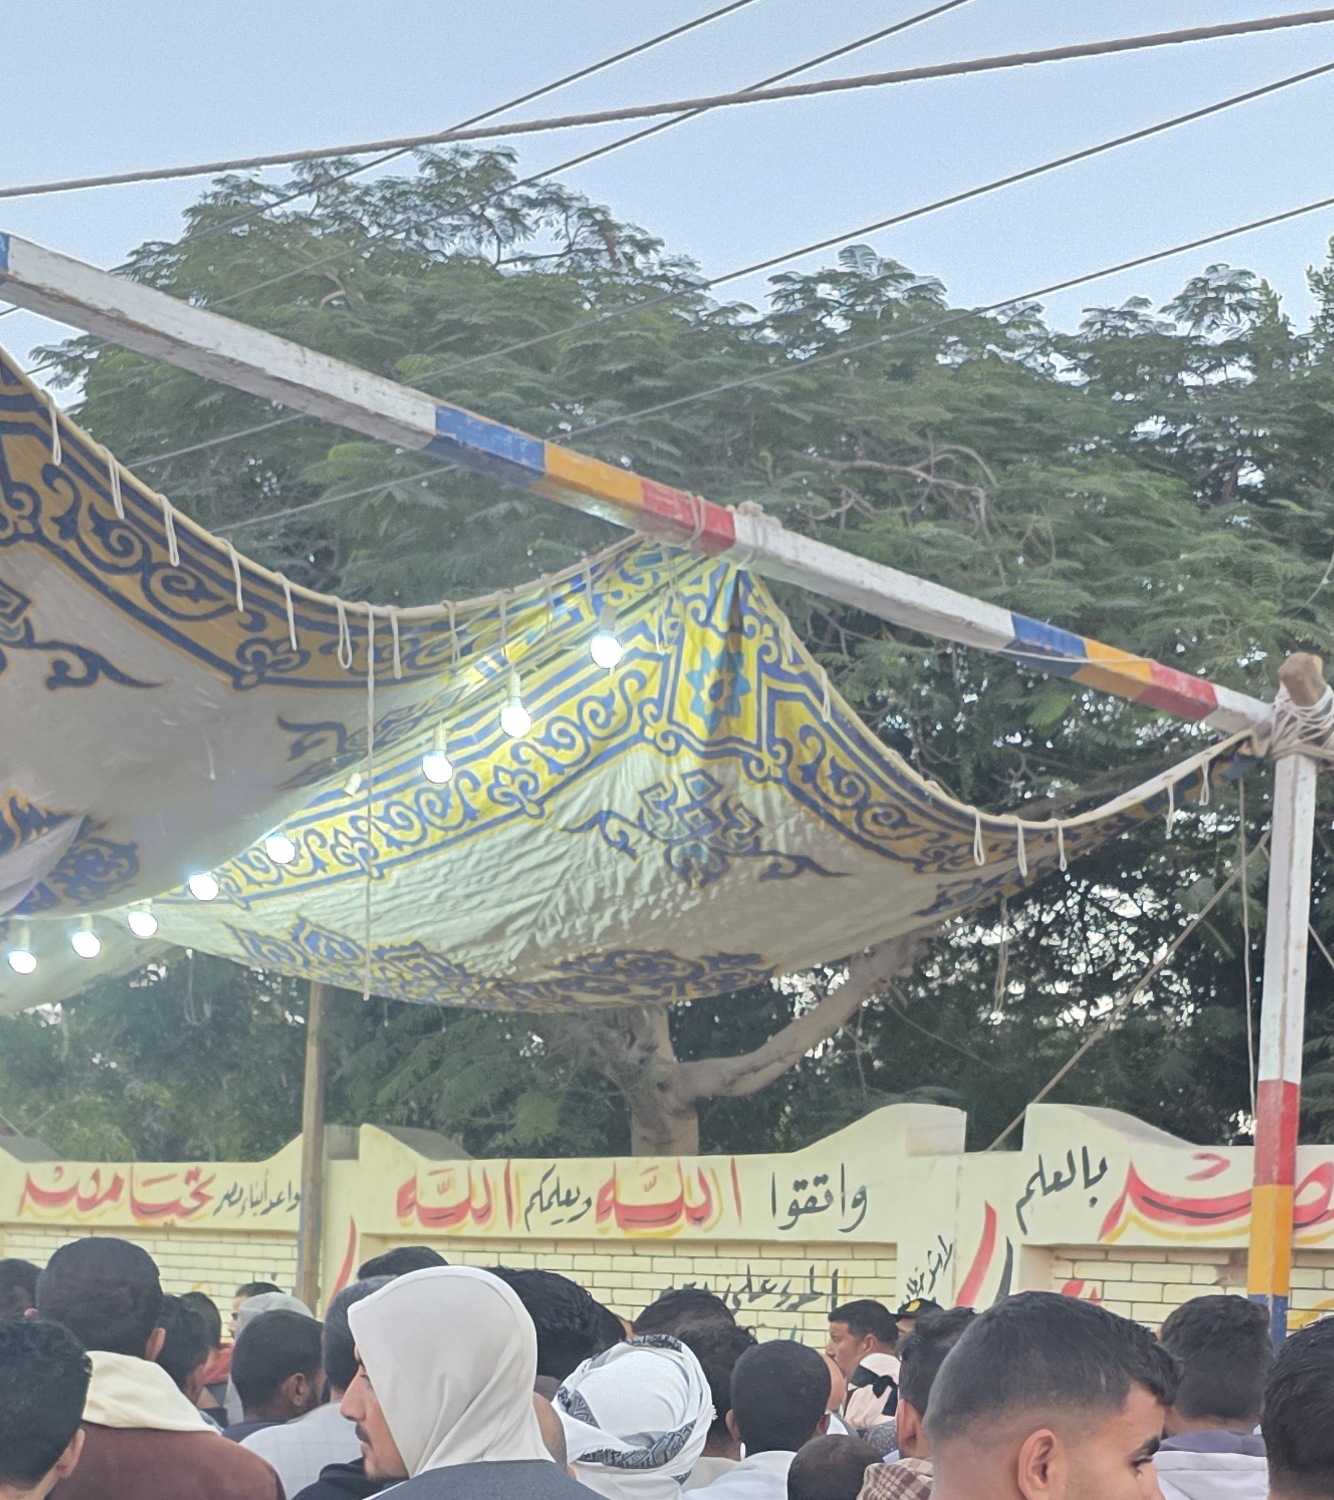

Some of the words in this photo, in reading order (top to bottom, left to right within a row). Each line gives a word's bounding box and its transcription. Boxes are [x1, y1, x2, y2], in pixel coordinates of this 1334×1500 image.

[17, 1165, 125, 1217] مصر
[129, 1163, 217, 1227] تحيا
[395, 1158, 515, 1231] الله
[524, 1163, 593, 1232] ويعلمكم
[595, 1155, 742, 1231] الله
[770, 1162, 868, 1233] واتقوا
[1016, 1145, 1108, 1235] بالعلم
